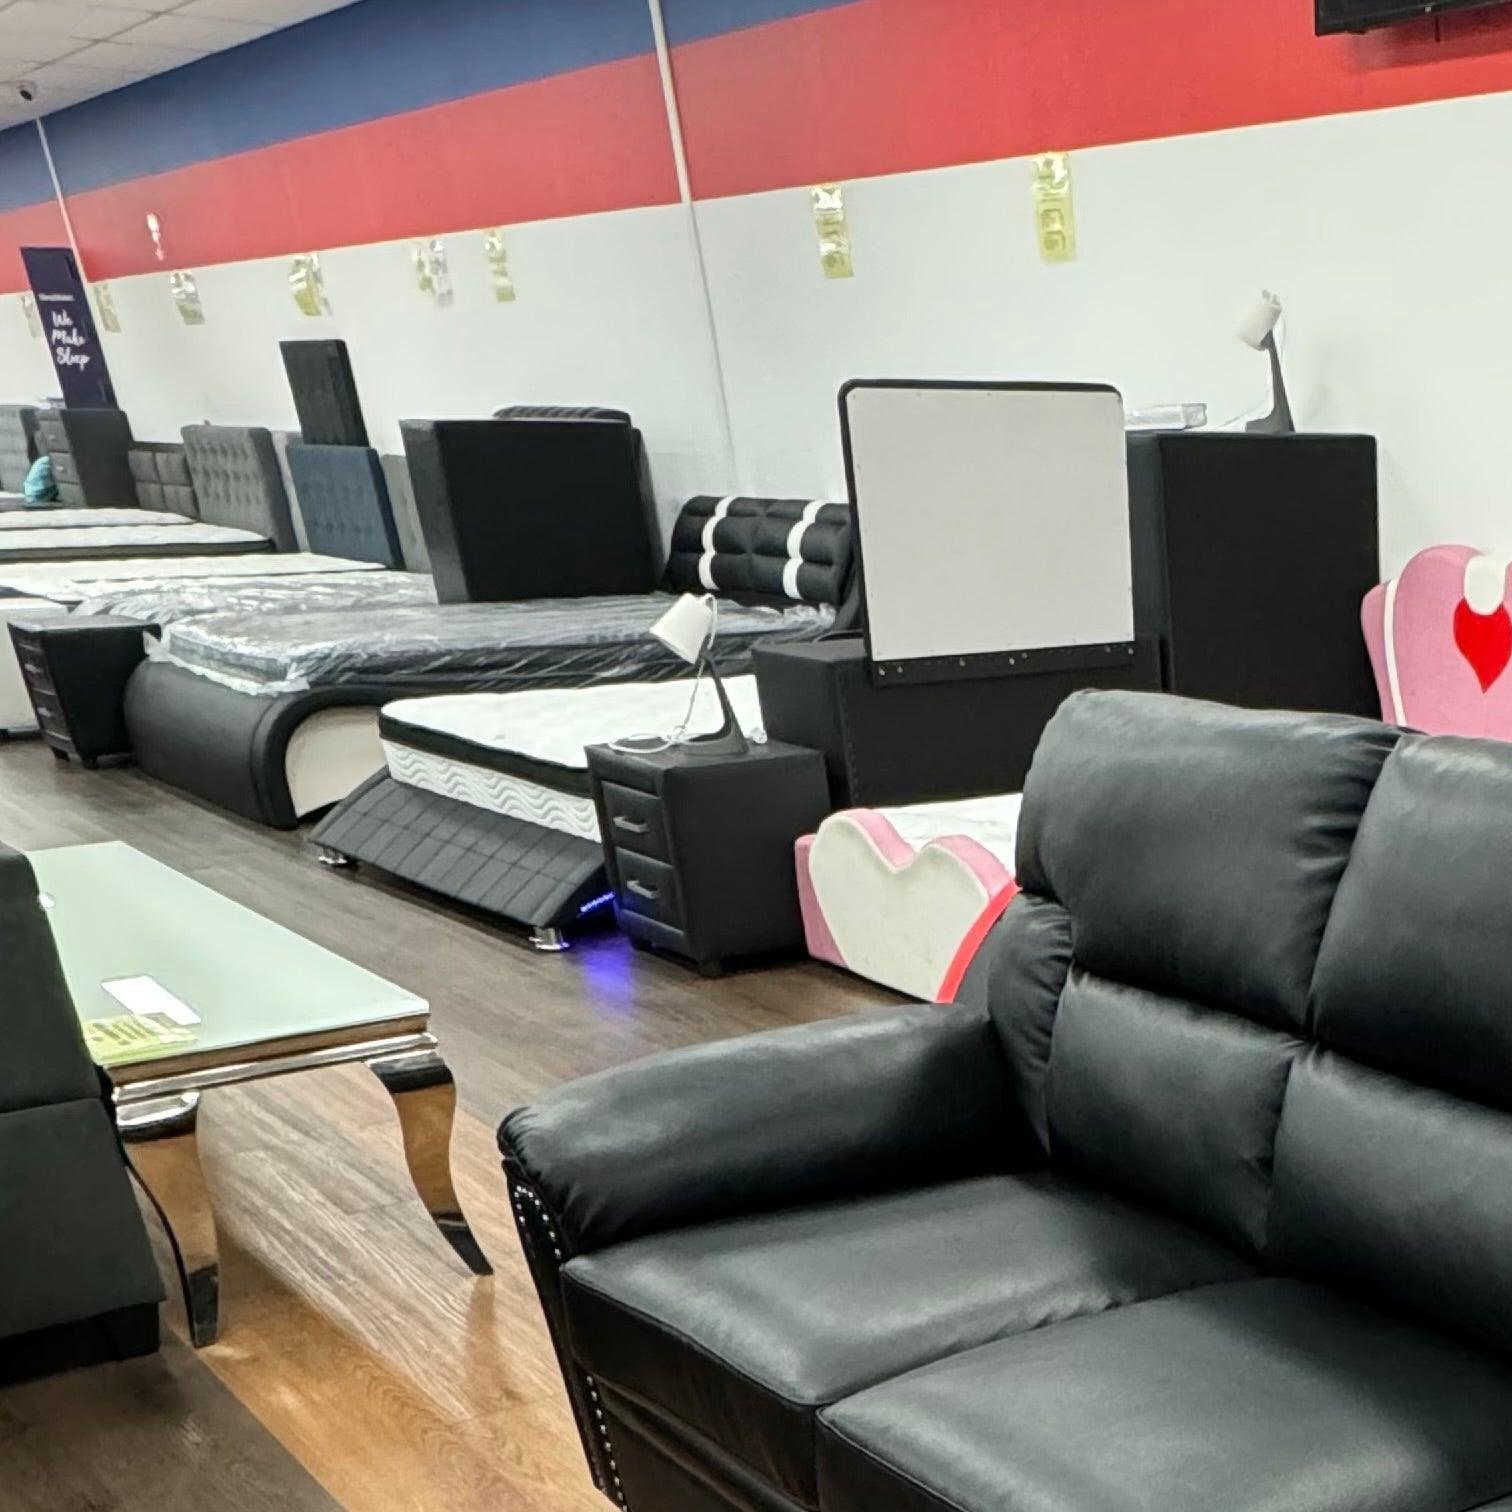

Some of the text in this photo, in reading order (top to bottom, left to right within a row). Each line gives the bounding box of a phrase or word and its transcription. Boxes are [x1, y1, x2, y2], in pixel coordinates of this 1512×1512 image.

[51, 308, 74, 327] We
[51, 327, 86, 347] Make
[56, 346, 90, 371] Sleep
